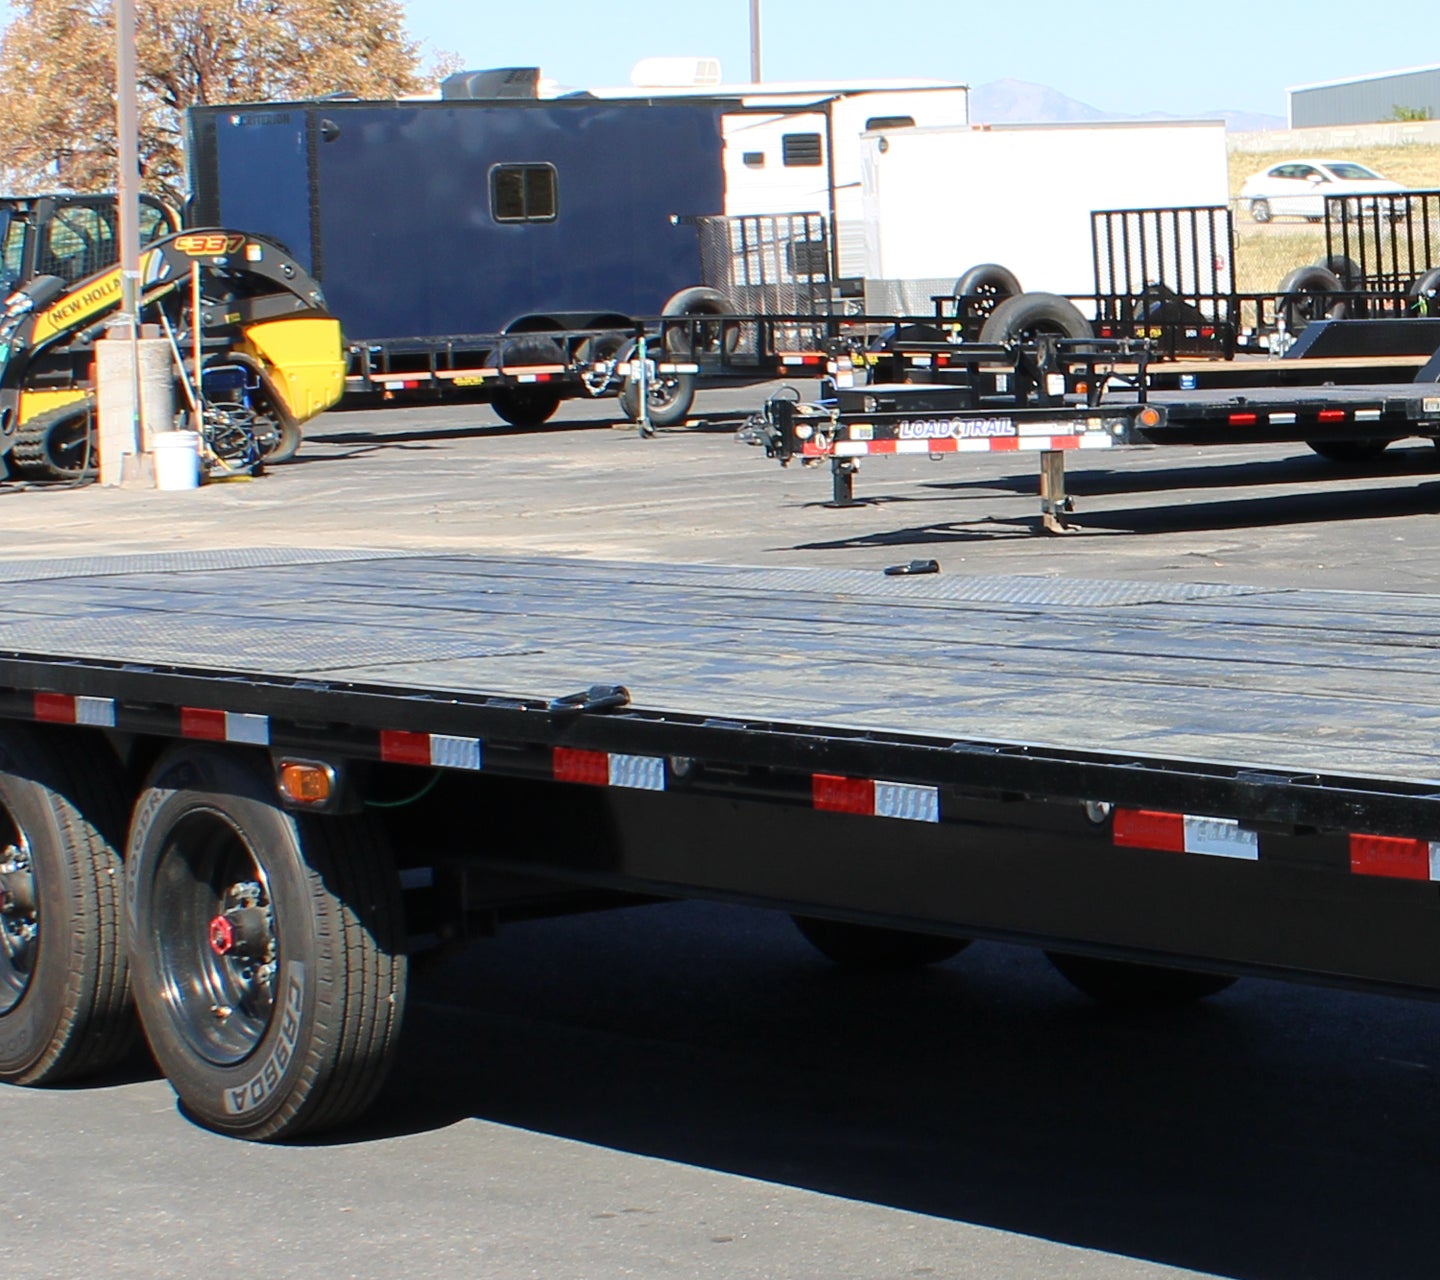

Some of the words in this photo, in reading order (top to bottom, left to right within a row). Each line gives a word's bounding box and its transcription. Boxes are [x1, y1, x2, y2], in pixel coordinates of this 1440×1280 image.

[52, 299, 82, 322] NEW
[84, 278, 122, 306] HOLLA
[901, 419, 952, 438] LOAD
[962, 418, 1016, 437] TRAIL
